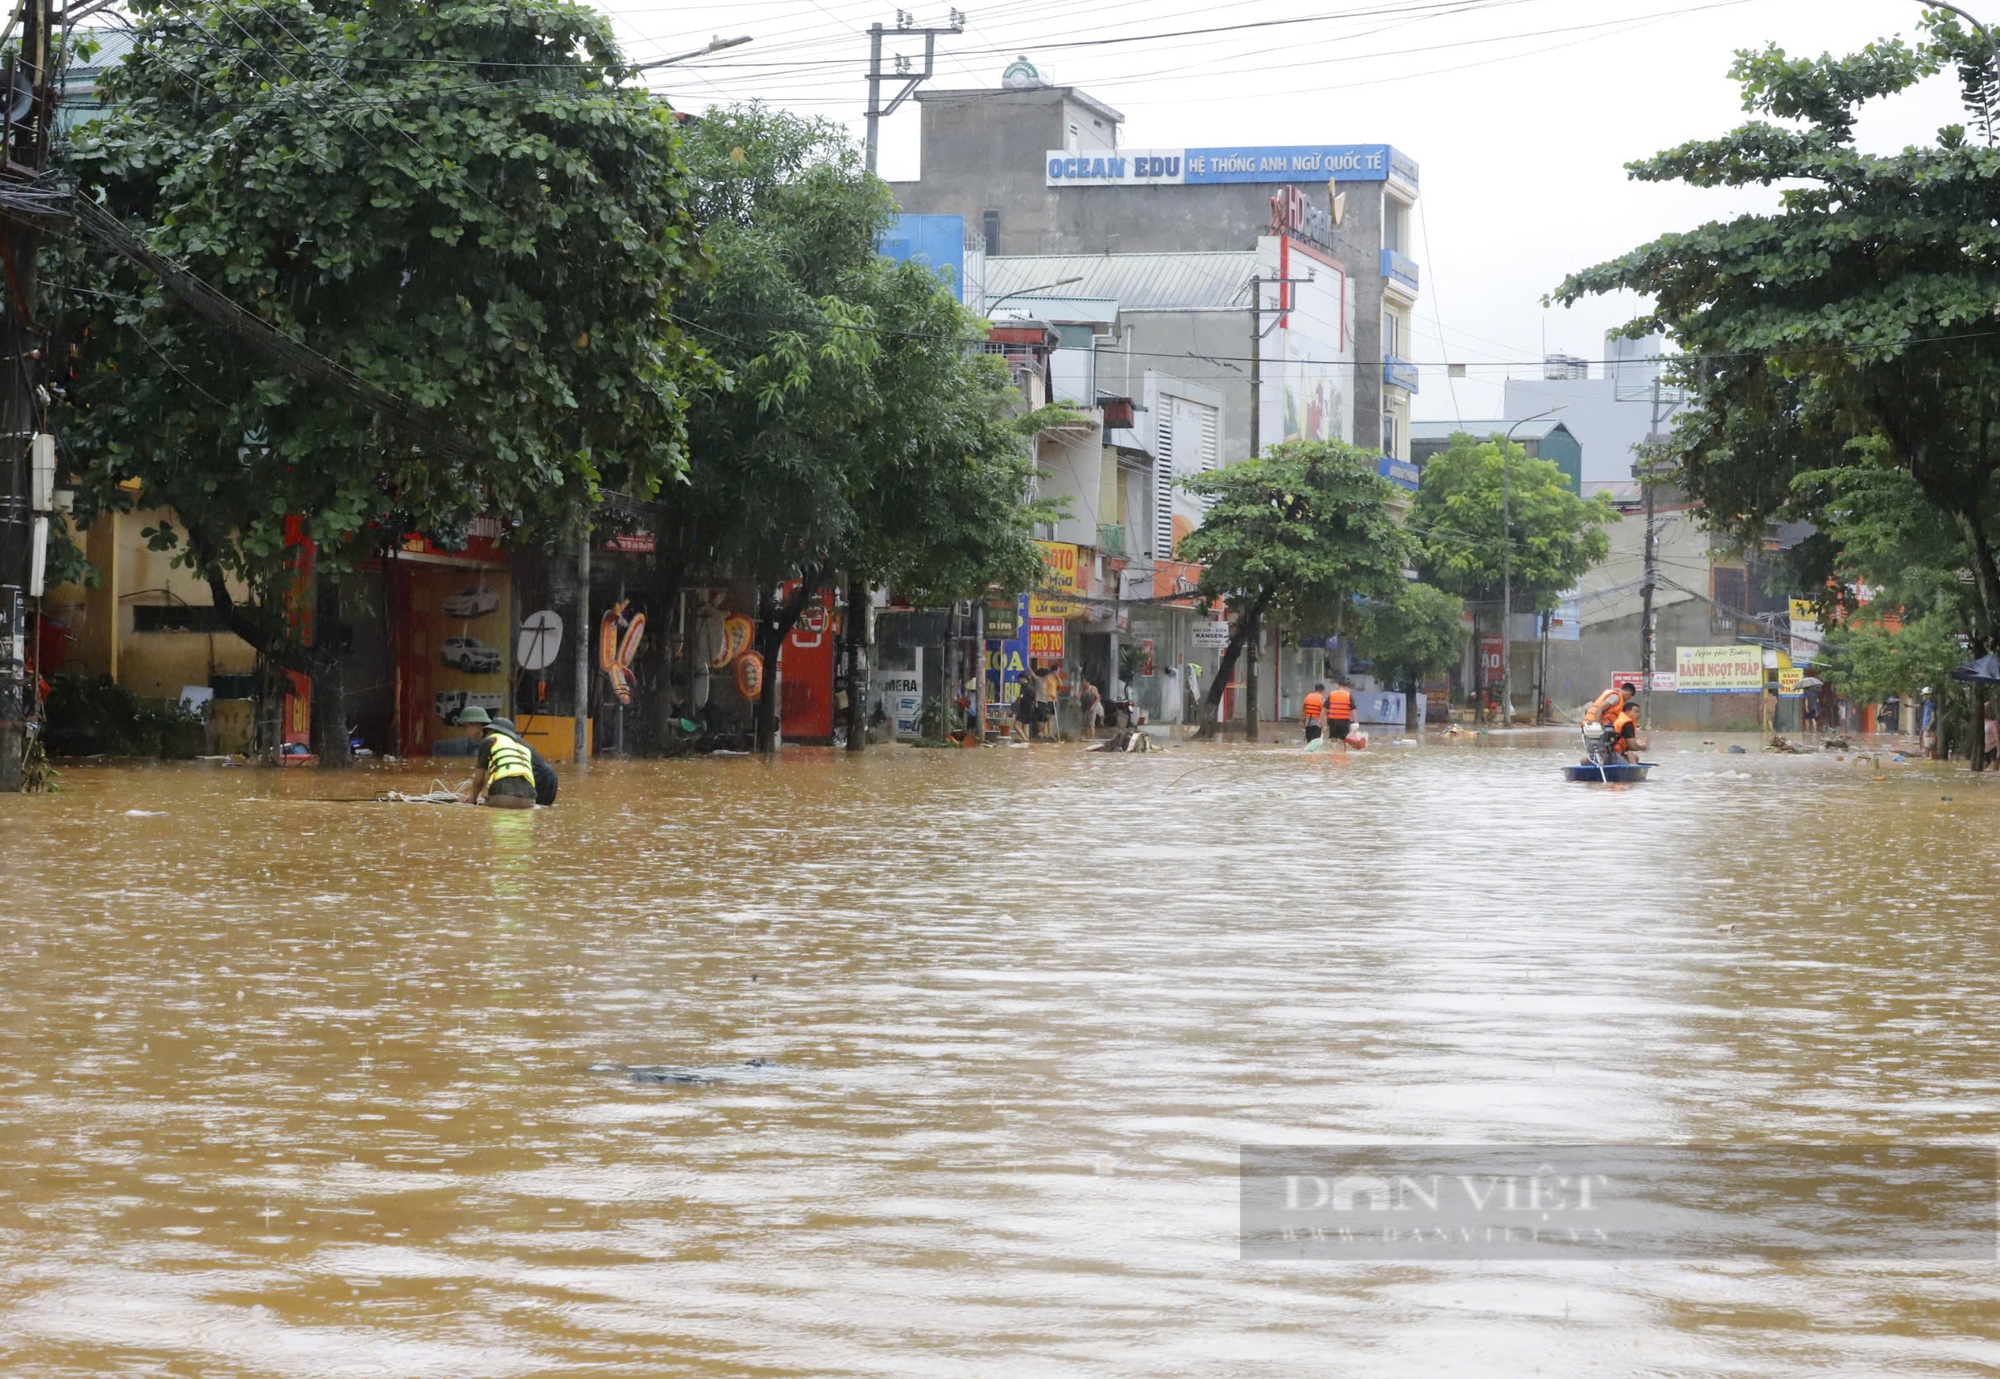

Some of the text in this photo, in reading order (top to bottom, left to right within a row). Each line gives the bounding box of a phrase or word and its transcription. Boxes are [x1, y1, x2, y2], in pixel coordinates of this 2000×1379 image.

[1048, 156, 1181, 179] OCEAN EDU
[1188, 149, 1384, 177] HỆ THỐNG ANH NGỮ QUỐC TẾ
[1707, 662, 1733, 680] NGỌT
[1735, 659, 1759, 676] PHÁP
